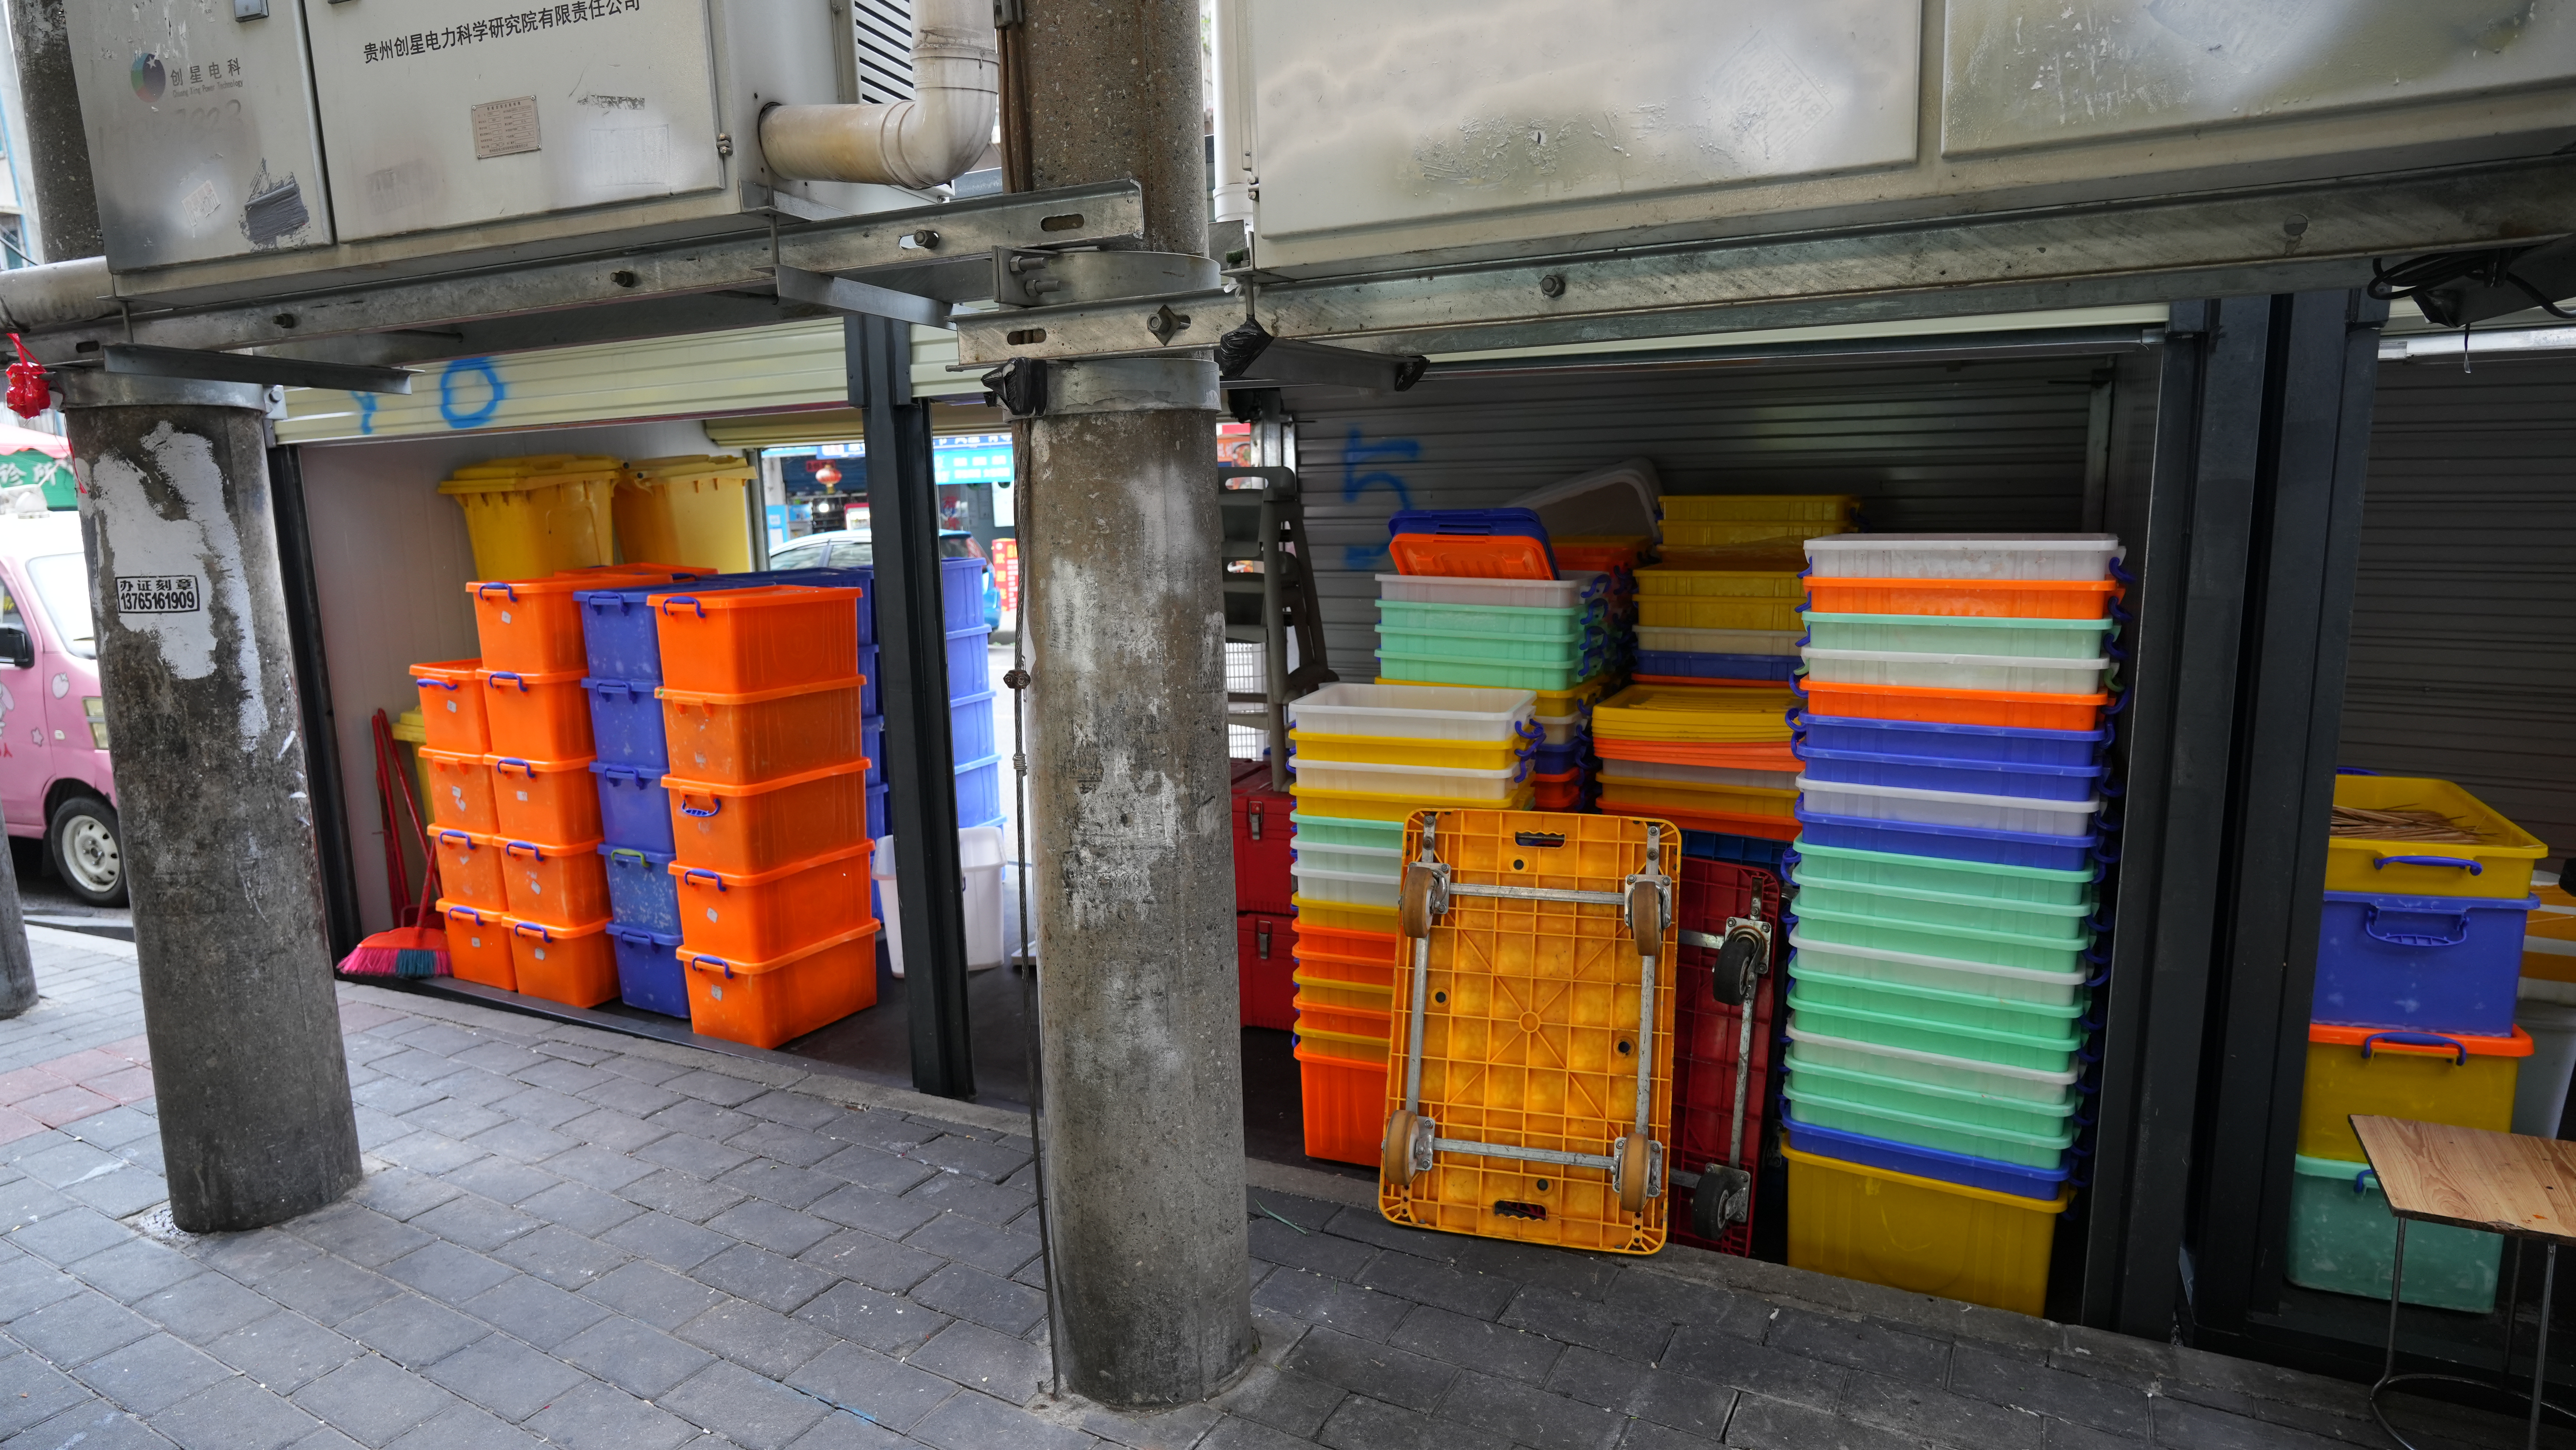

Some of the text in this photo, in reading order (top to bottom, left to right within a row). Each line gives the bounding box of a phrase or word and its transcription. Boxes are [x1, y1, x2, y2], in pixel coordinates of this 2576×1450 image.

[363, 0, 640, 64] 贵州创星电力科学研究院有限责任公司
[170, 57, 241, 86] 创星电科
[120, 579, 193, 592] 办证刻章
[121, 591, 195, 610] 13765161909
